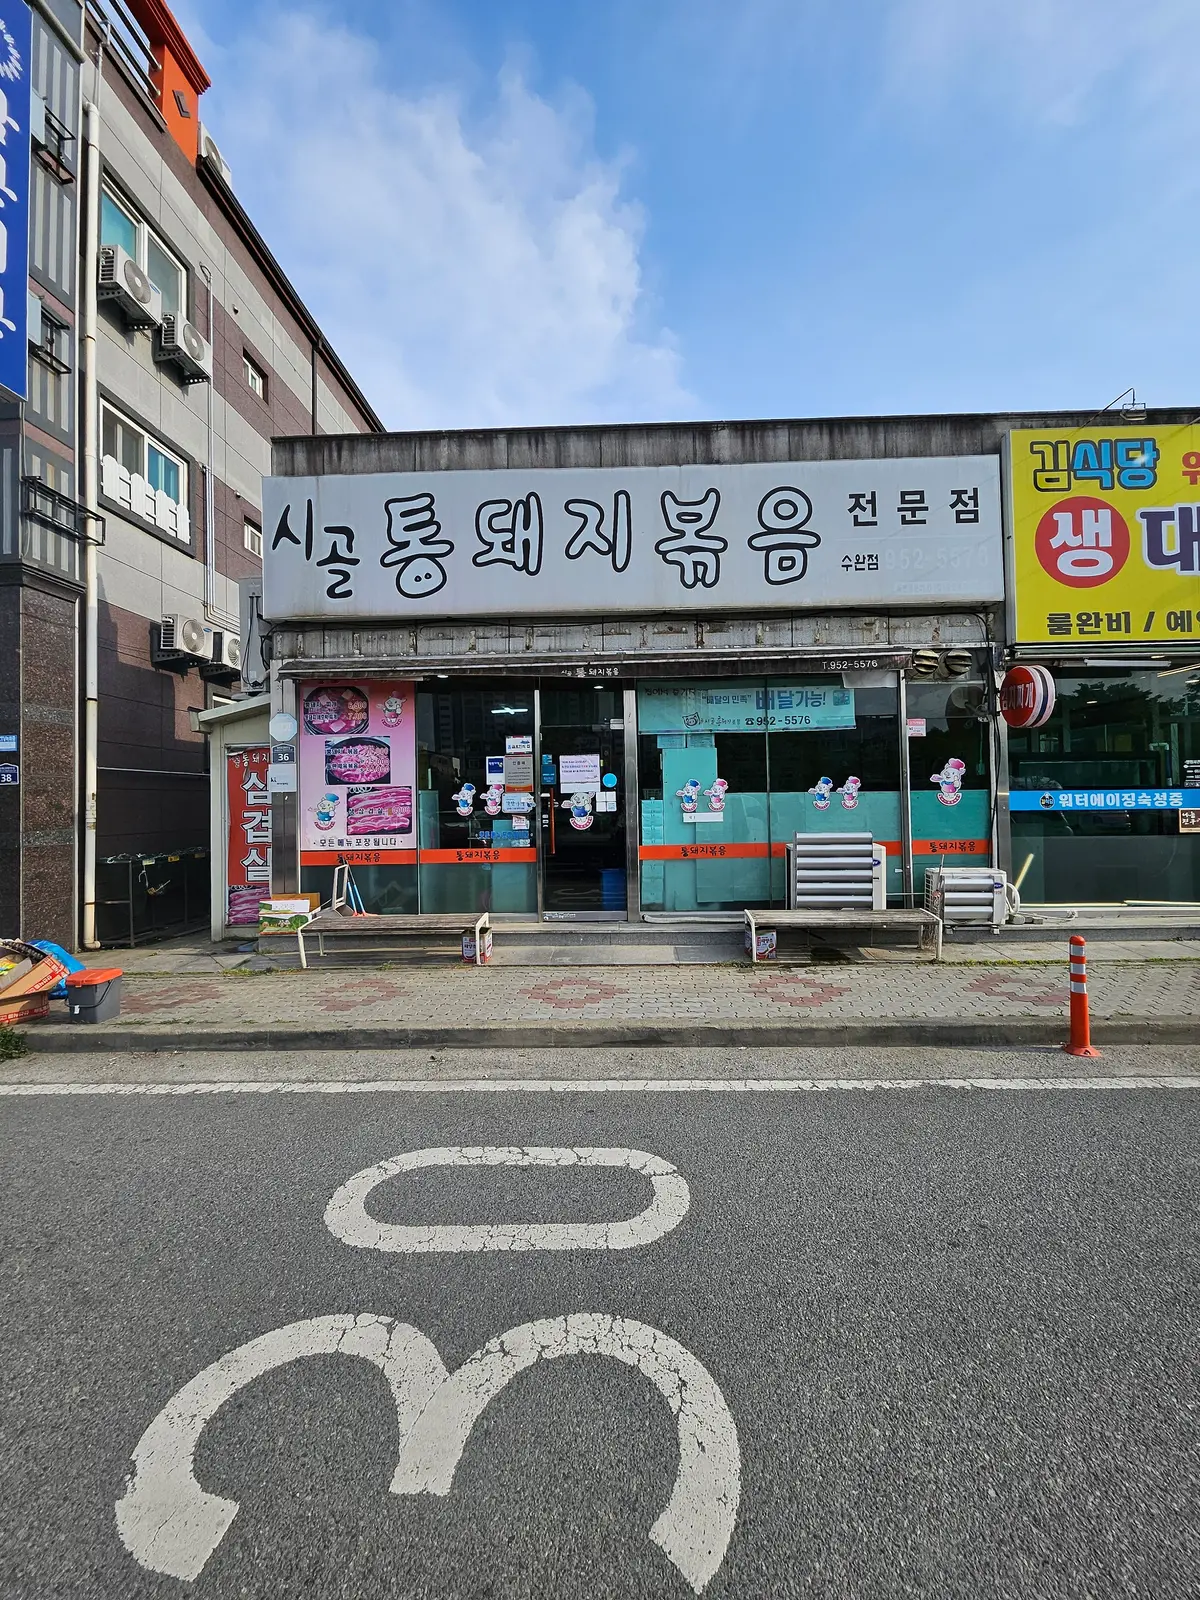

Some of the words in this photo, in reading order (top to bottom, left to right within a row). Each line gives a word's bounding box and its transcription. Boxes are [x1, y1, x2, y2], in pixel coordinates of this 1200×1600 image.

[1030, 437, 1160, 492] 김식당
[272, 498, 361, 600] 시골
[847, 487, 980, 527] 전문점
[1050, 508, 1114, 578] 생
[841, 554, 879, 572] 수완점
[1046, 610, 1131, 637] 룸완비
[822, 660, 879, 670] T.952-5576
[756, 715, 811, 727] 952-5576
[277, 753, 290, 762] 36
[0, 773, 13, 783] 38
[1059, 792, 1184, 808] 워터에이징숙성중
[240, 768, 272, 882] 삼겹살
[355, 838, 371, 847] 포장
[930, 841, 976, 853] 통돼지볶음
[456, 850, 500, 861] 통돼지볶음
[681, 845, 726, 857] 통돼지볶음
